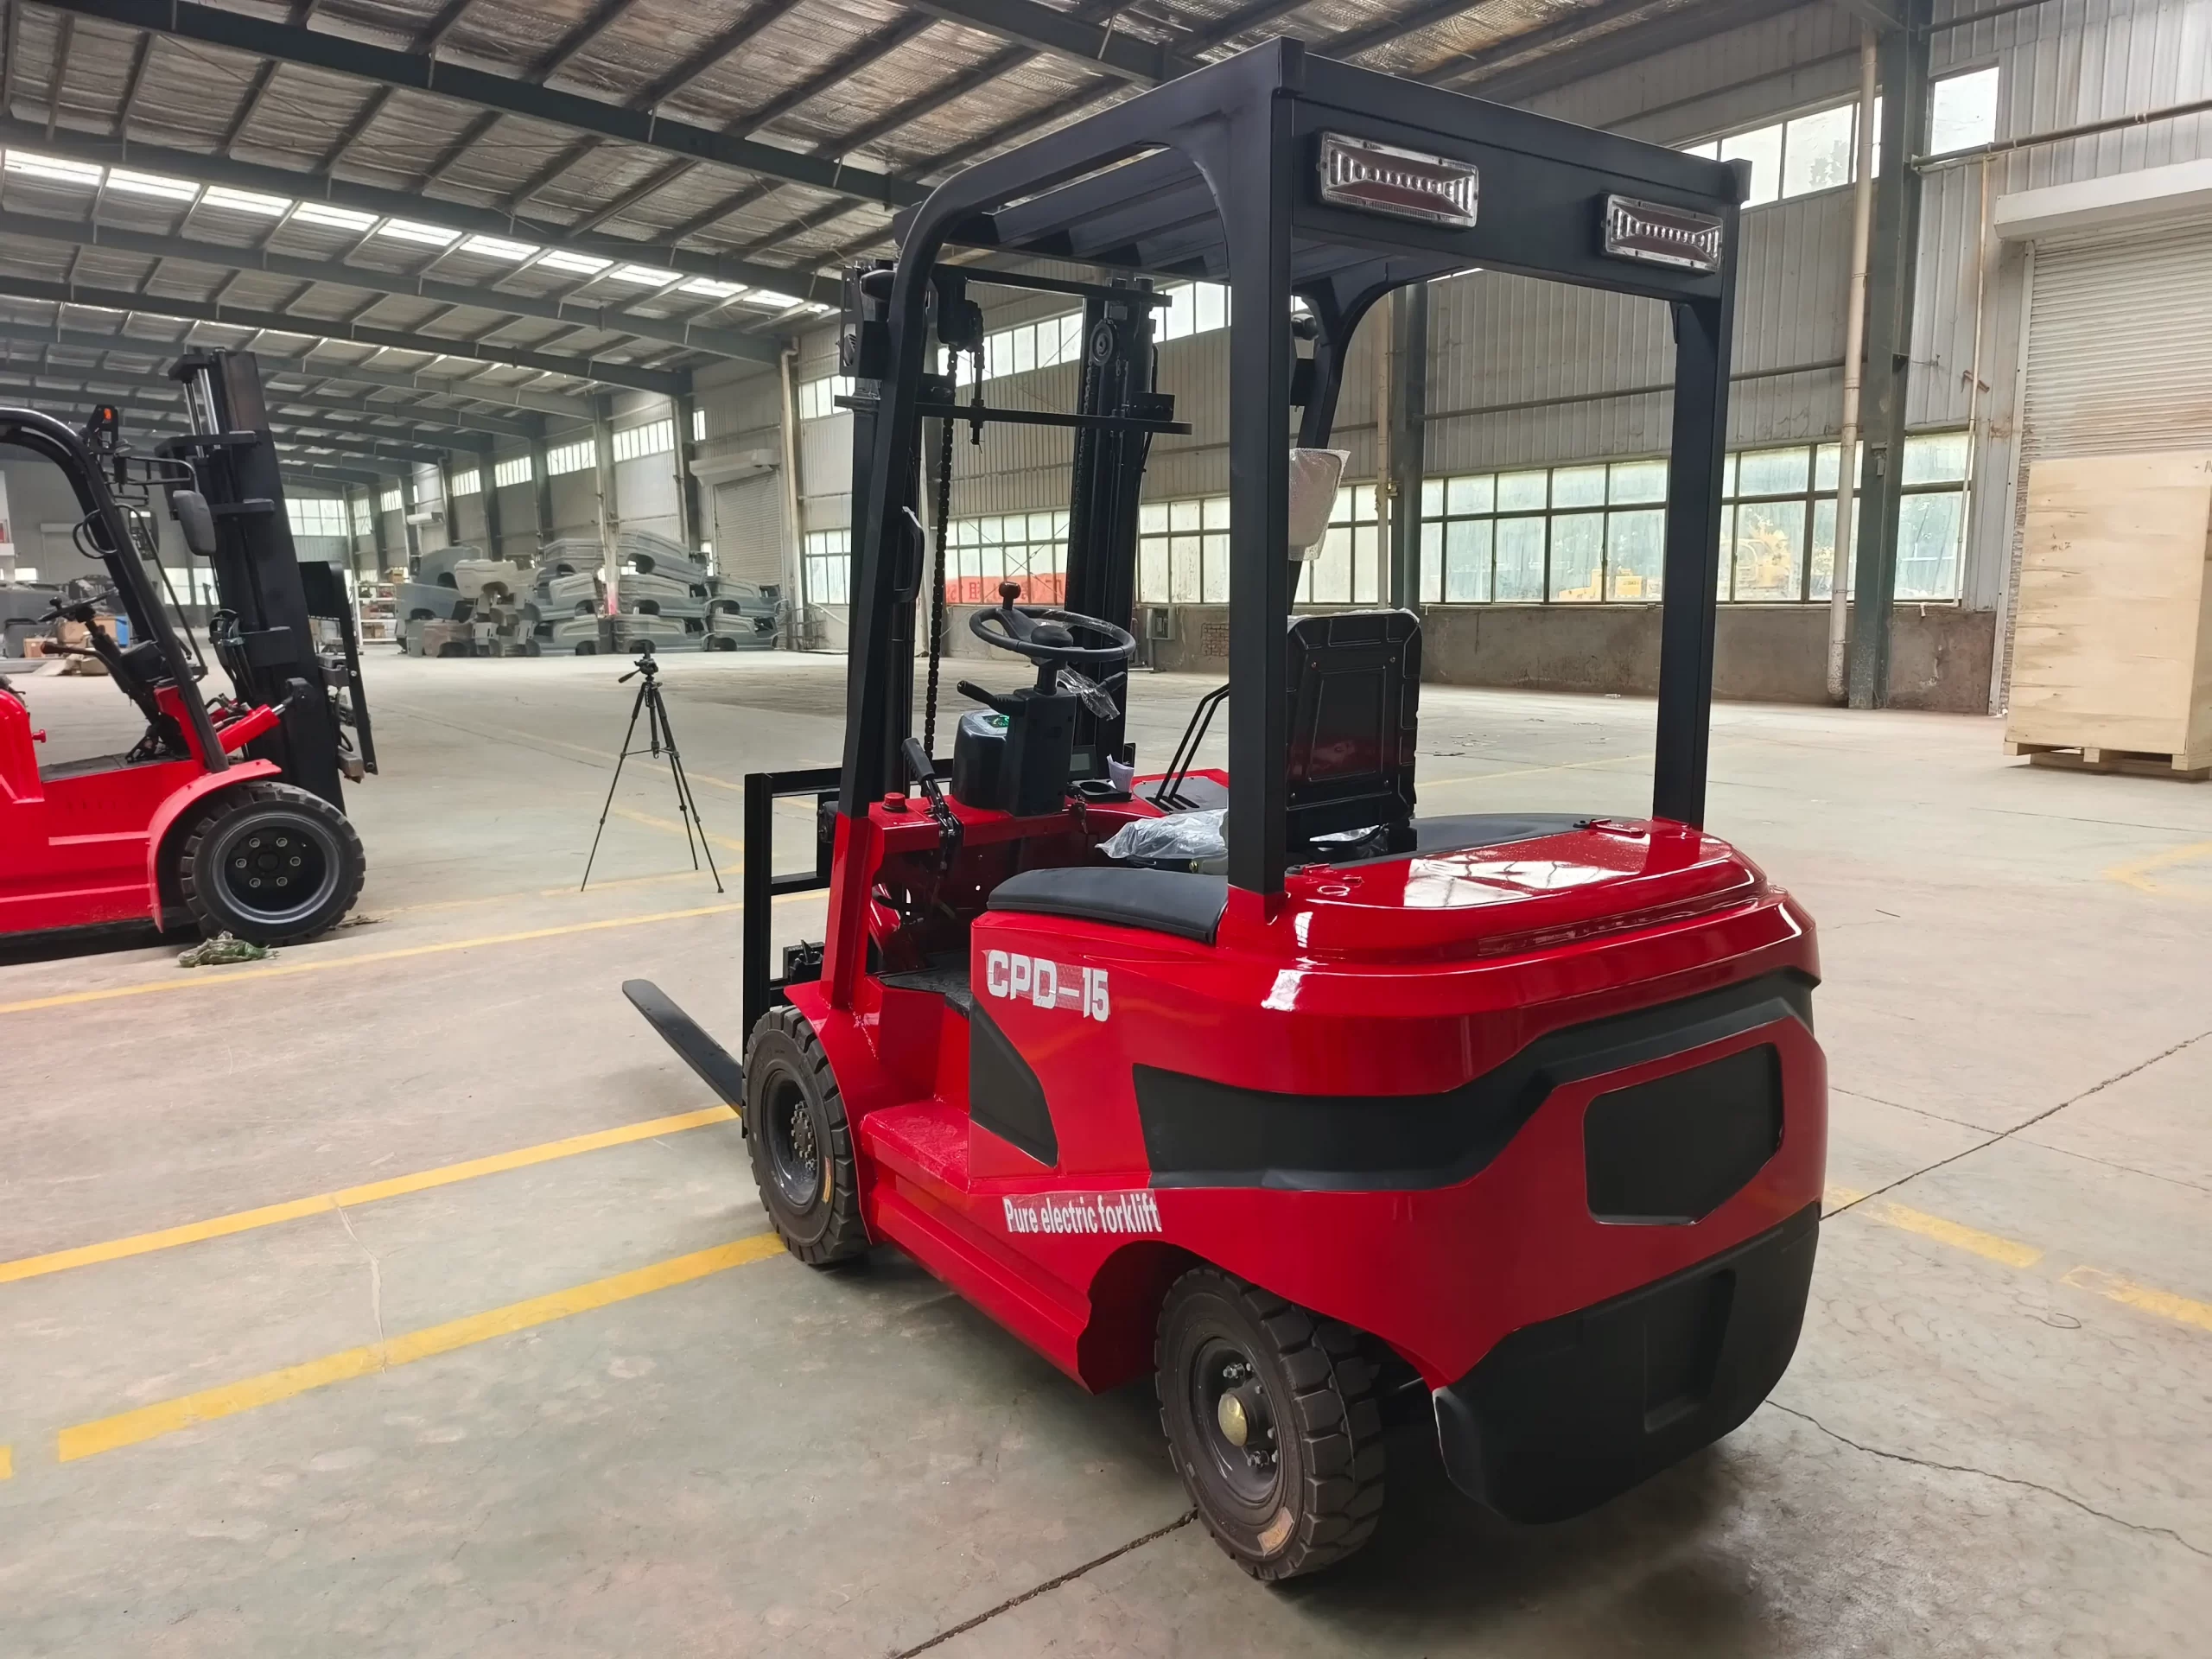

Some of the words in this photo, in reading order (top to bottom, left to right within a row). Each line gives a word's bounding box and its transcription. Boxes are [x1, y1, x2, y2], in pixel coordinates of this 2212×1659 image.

[988, 950, 1109, 1022] CPD-15
[1003, 1198, 1039, 1233] Pure
[1040, 1197, 1097, 1233] electric
[1097, 1192, 1162, 1233] forklift
